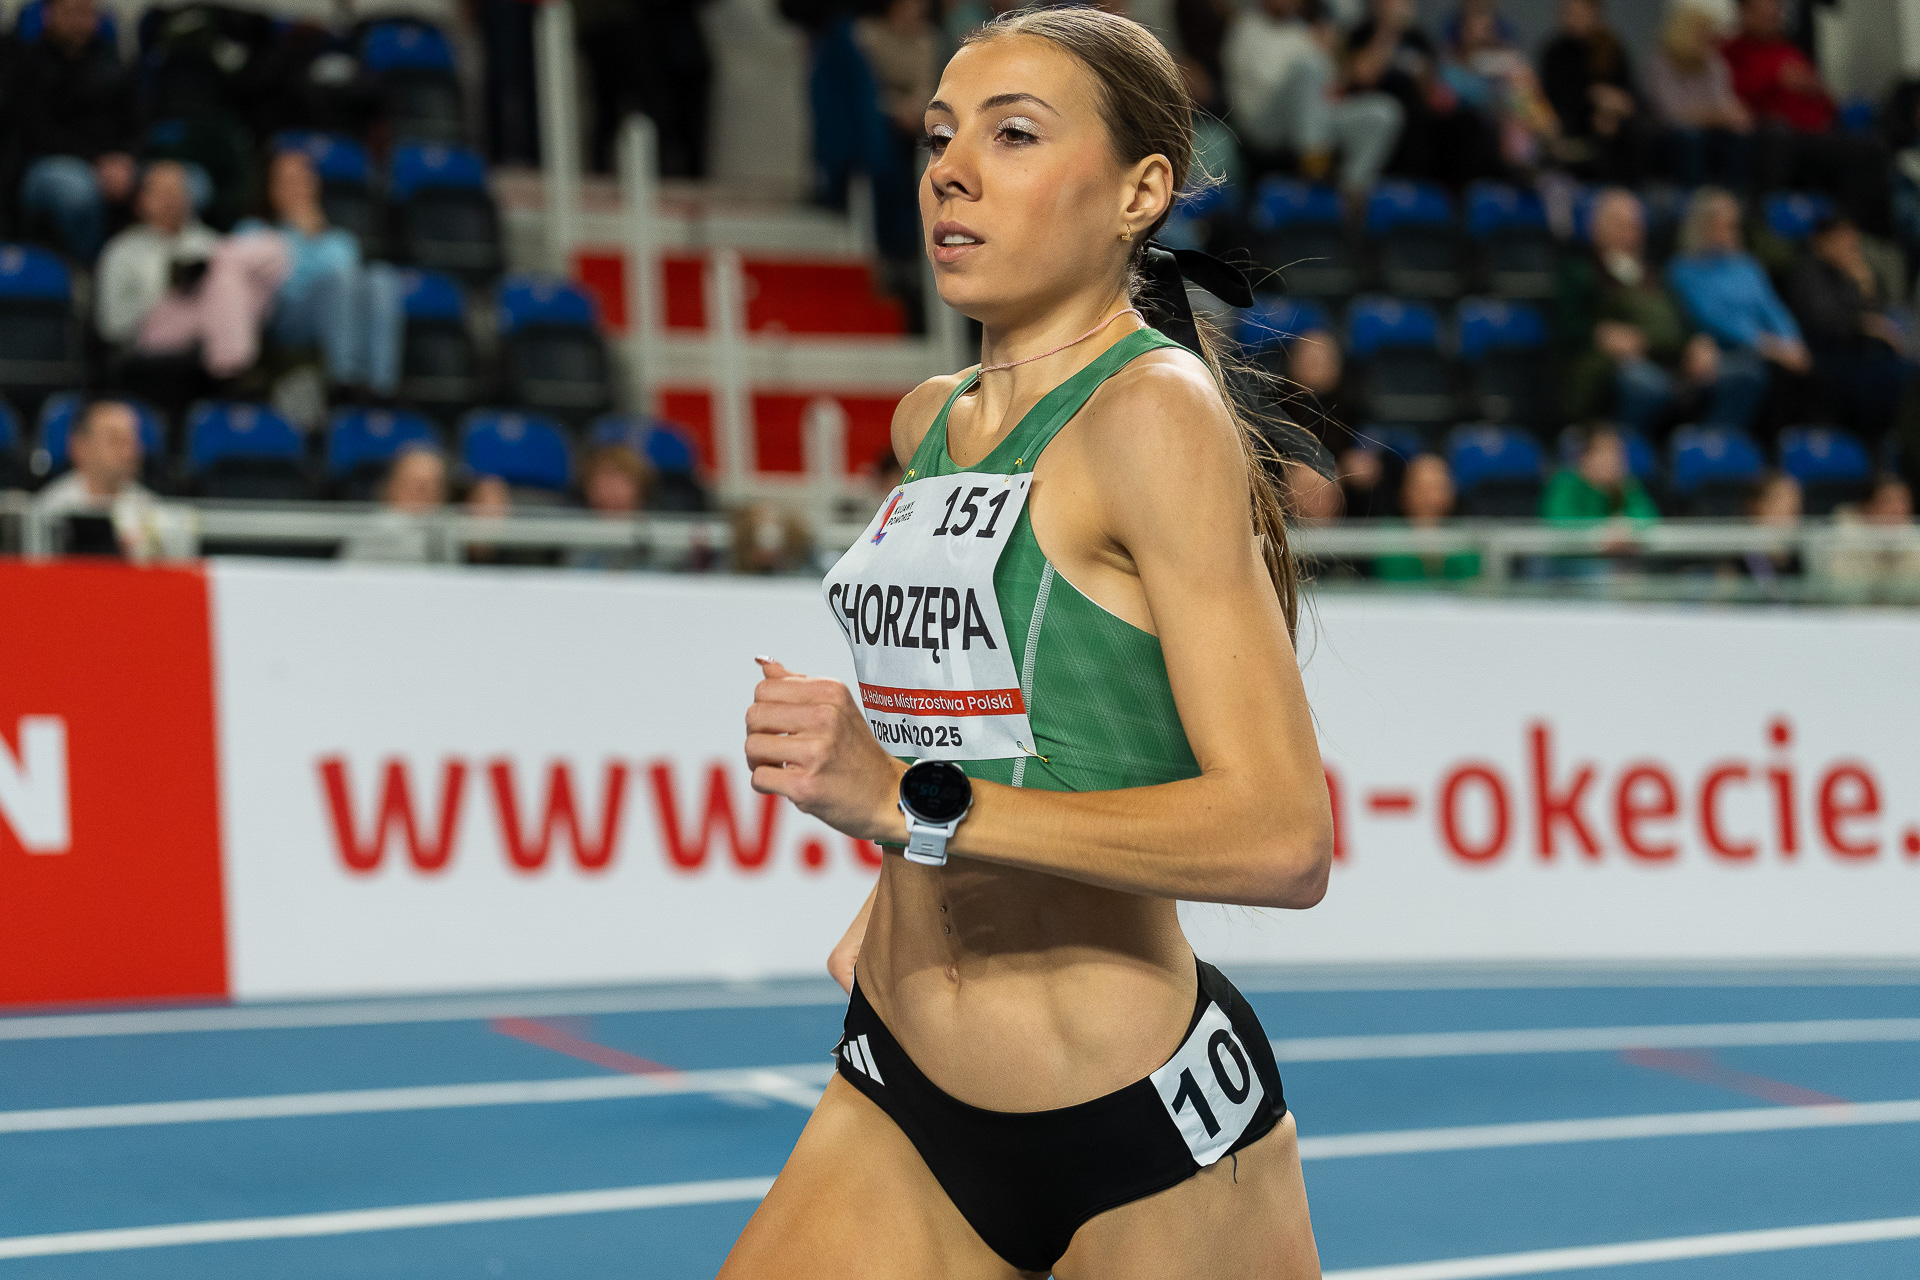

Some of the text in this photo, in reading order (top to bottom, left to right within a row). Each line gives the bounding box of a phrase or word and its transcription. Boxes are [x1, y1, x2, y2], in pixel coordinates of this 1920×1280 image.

[933, 486, 1011, 538] 151
[828, 582, 998, 664] CHORZĘPA
[893, 692, 965, 711] Mistrzostwa
[966, 693, 1014, 711] Polski
[870, 717, 963, 748] TORUŃ 2025
[1171, 1028, 1251, 1140] 10
